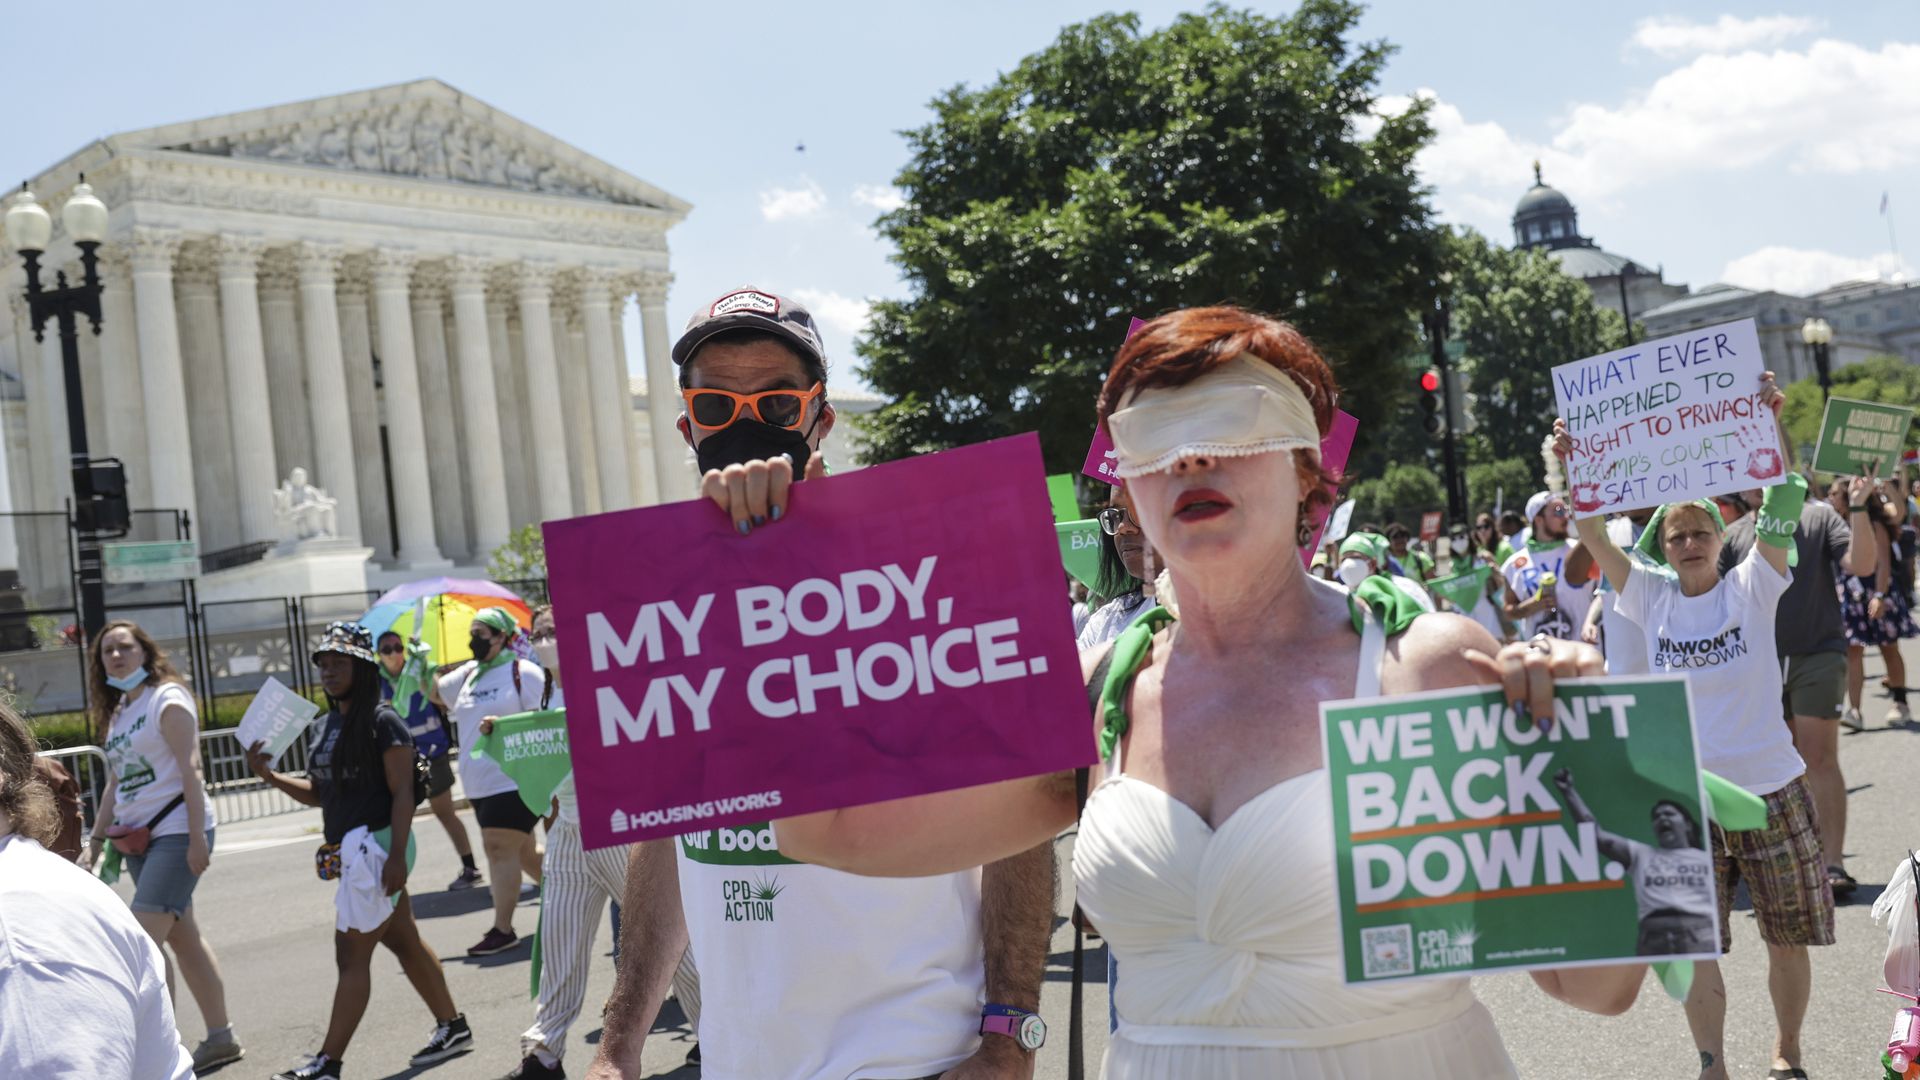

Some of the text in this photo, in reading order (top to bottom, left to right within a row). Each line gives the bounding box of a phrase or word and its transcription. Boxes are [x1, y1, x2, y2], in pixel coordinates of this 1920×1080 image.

[748, 293, 774, 308] Gump
[1558, 333, 1736, 402] WHAT EVER
[1566, 372, 1735, 432] HAPPENED TO
[1569, 392, 1765, 462] RIGHT TO PRIVACY?
[1660, 431, 1737, 466] COURT
[1604, 459, 1737, 506] SAT ON IT
[585, 555, 954, 672] MY BODY,
[1655, 640, 1748, 668] BACK DOWN
[1678, 626, 1741, 655] WON'T
[596, 617, 1048, 747] MY CHOICE.
[503, 728, 565, 748] WE WON'T
[1338, 694, 1636, 766] WE WON'T
[504, 742, 568, 762] BACK DOWN
[630, 790, 782, 830] HOUSING WORKS
[1346, 752, 1562, 834] BACK
[718, 821, 778, 852] bod
[1351, 822, 1625, 905] DOWN.
[1644, 875, 1706, 887] BODIES
[723, 880, 774, 922] CPD ACTION
[1418, 929, 1449, 950] CPD
[1419, 944, 1474, 970] ACTION
